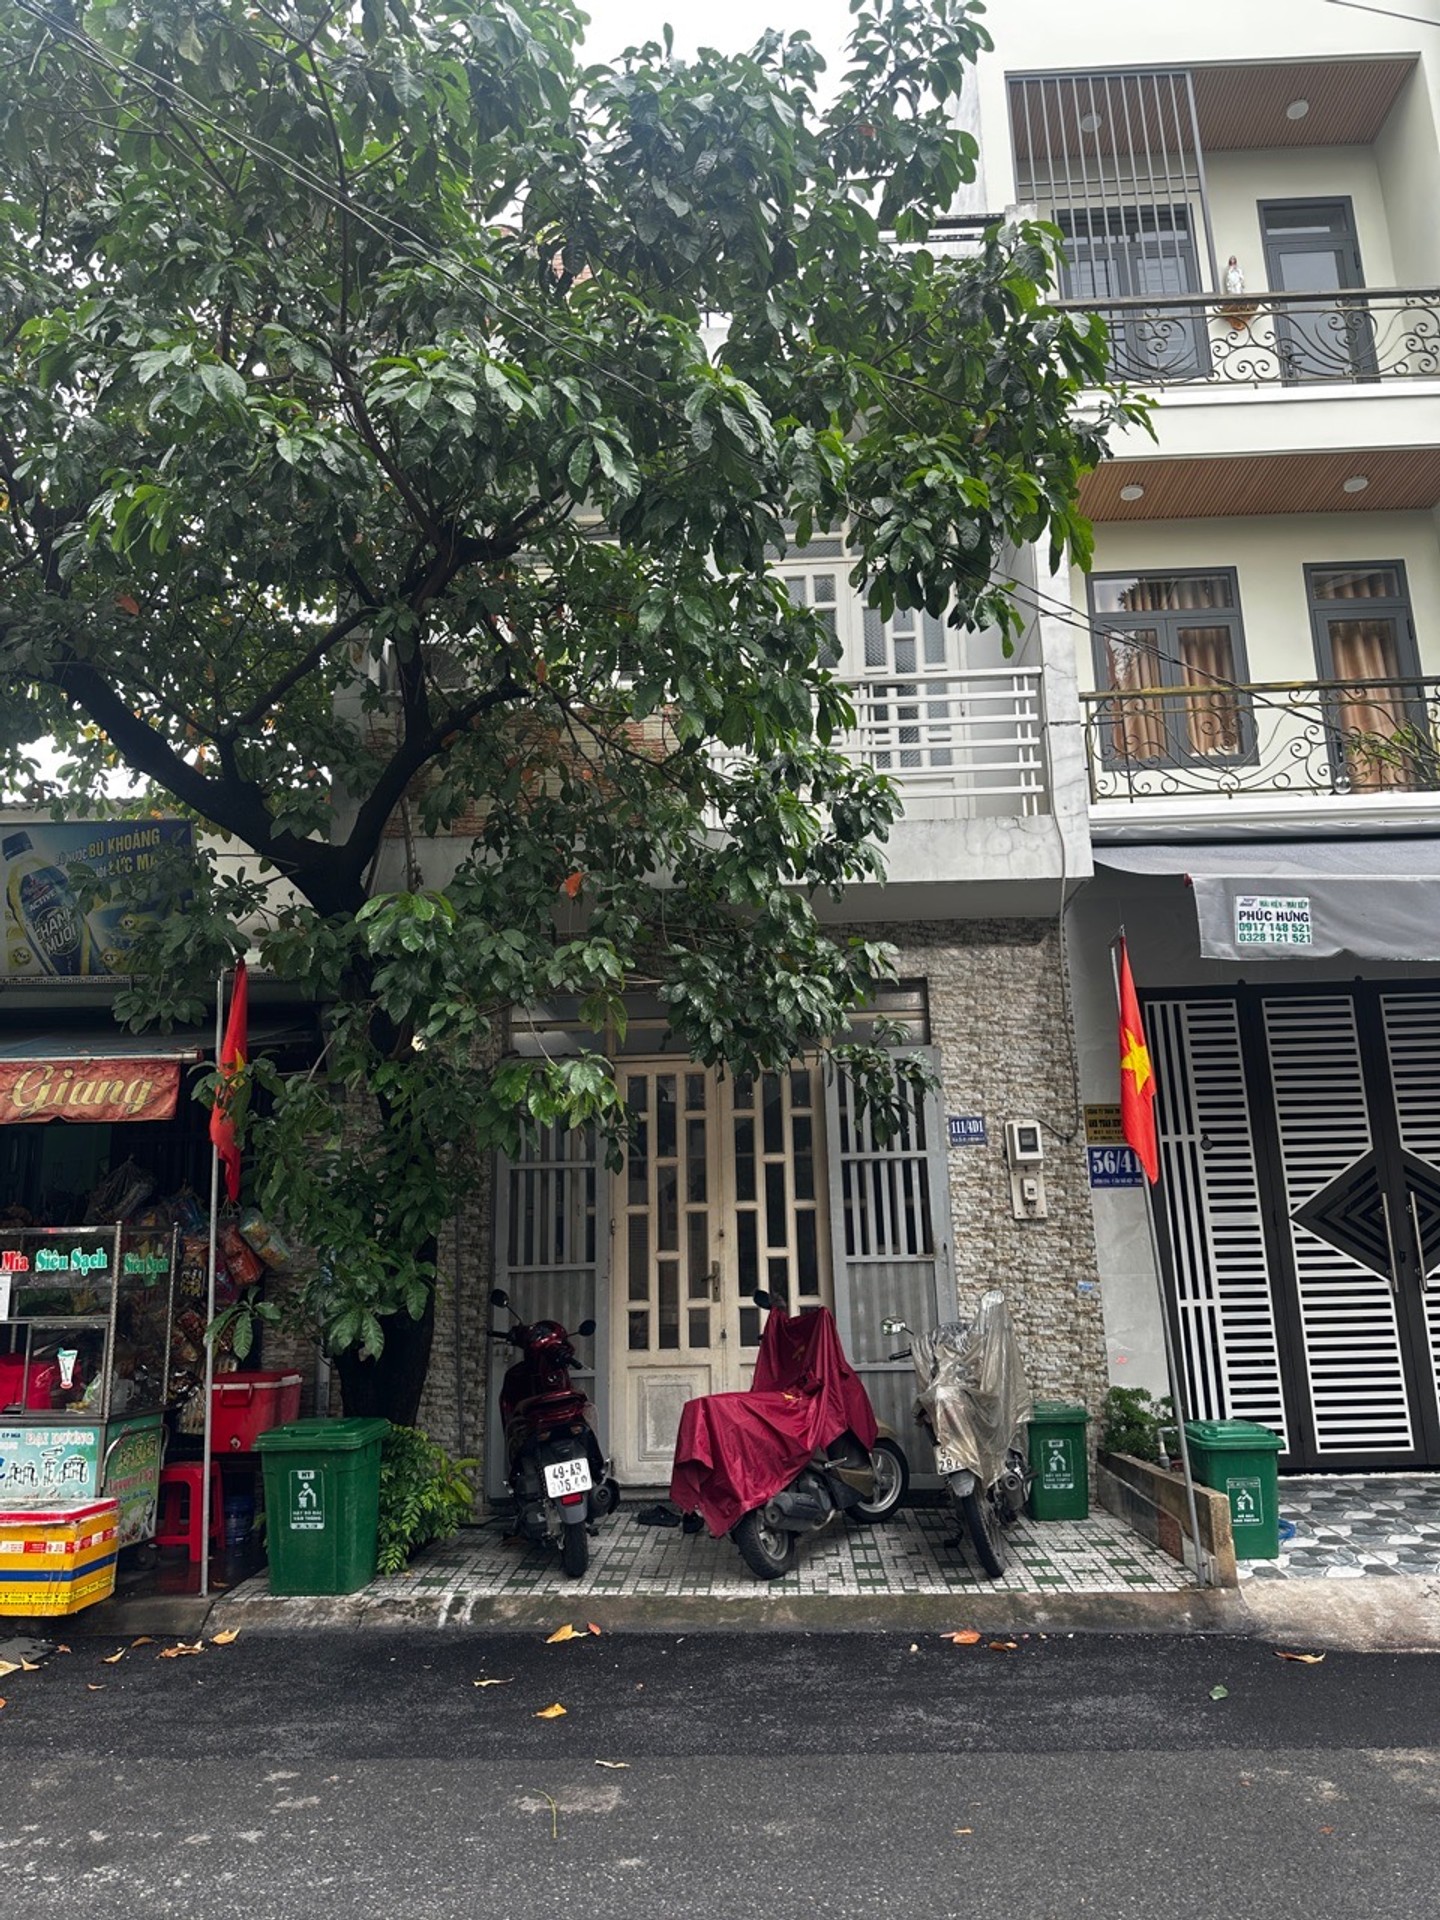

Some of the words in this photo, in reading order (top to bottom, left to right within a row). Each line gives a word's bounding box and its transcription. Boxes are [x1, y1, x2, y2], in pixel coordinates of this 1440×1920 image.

[107, 828, 160, 854] KHOÁNG
[1239, 908, 1272, 921] PHÚC
[1276, 910, 1309, 922] HƯNG
[1239, 922, 1265, 931] 0917
[1292, 923, 1310, 932] 521
[1239, 933, 1266, 942] 0328
[1270, 933, 1288, 942] 121
[1292, 934, 1310, 943] 521
[8, 1065, 154, 1118] Giang
[1, 1250, 29, 1272] Mía
[35, 1248, 68, 1272] Siêu
[71, 1247, 108, 1276] Sạch
